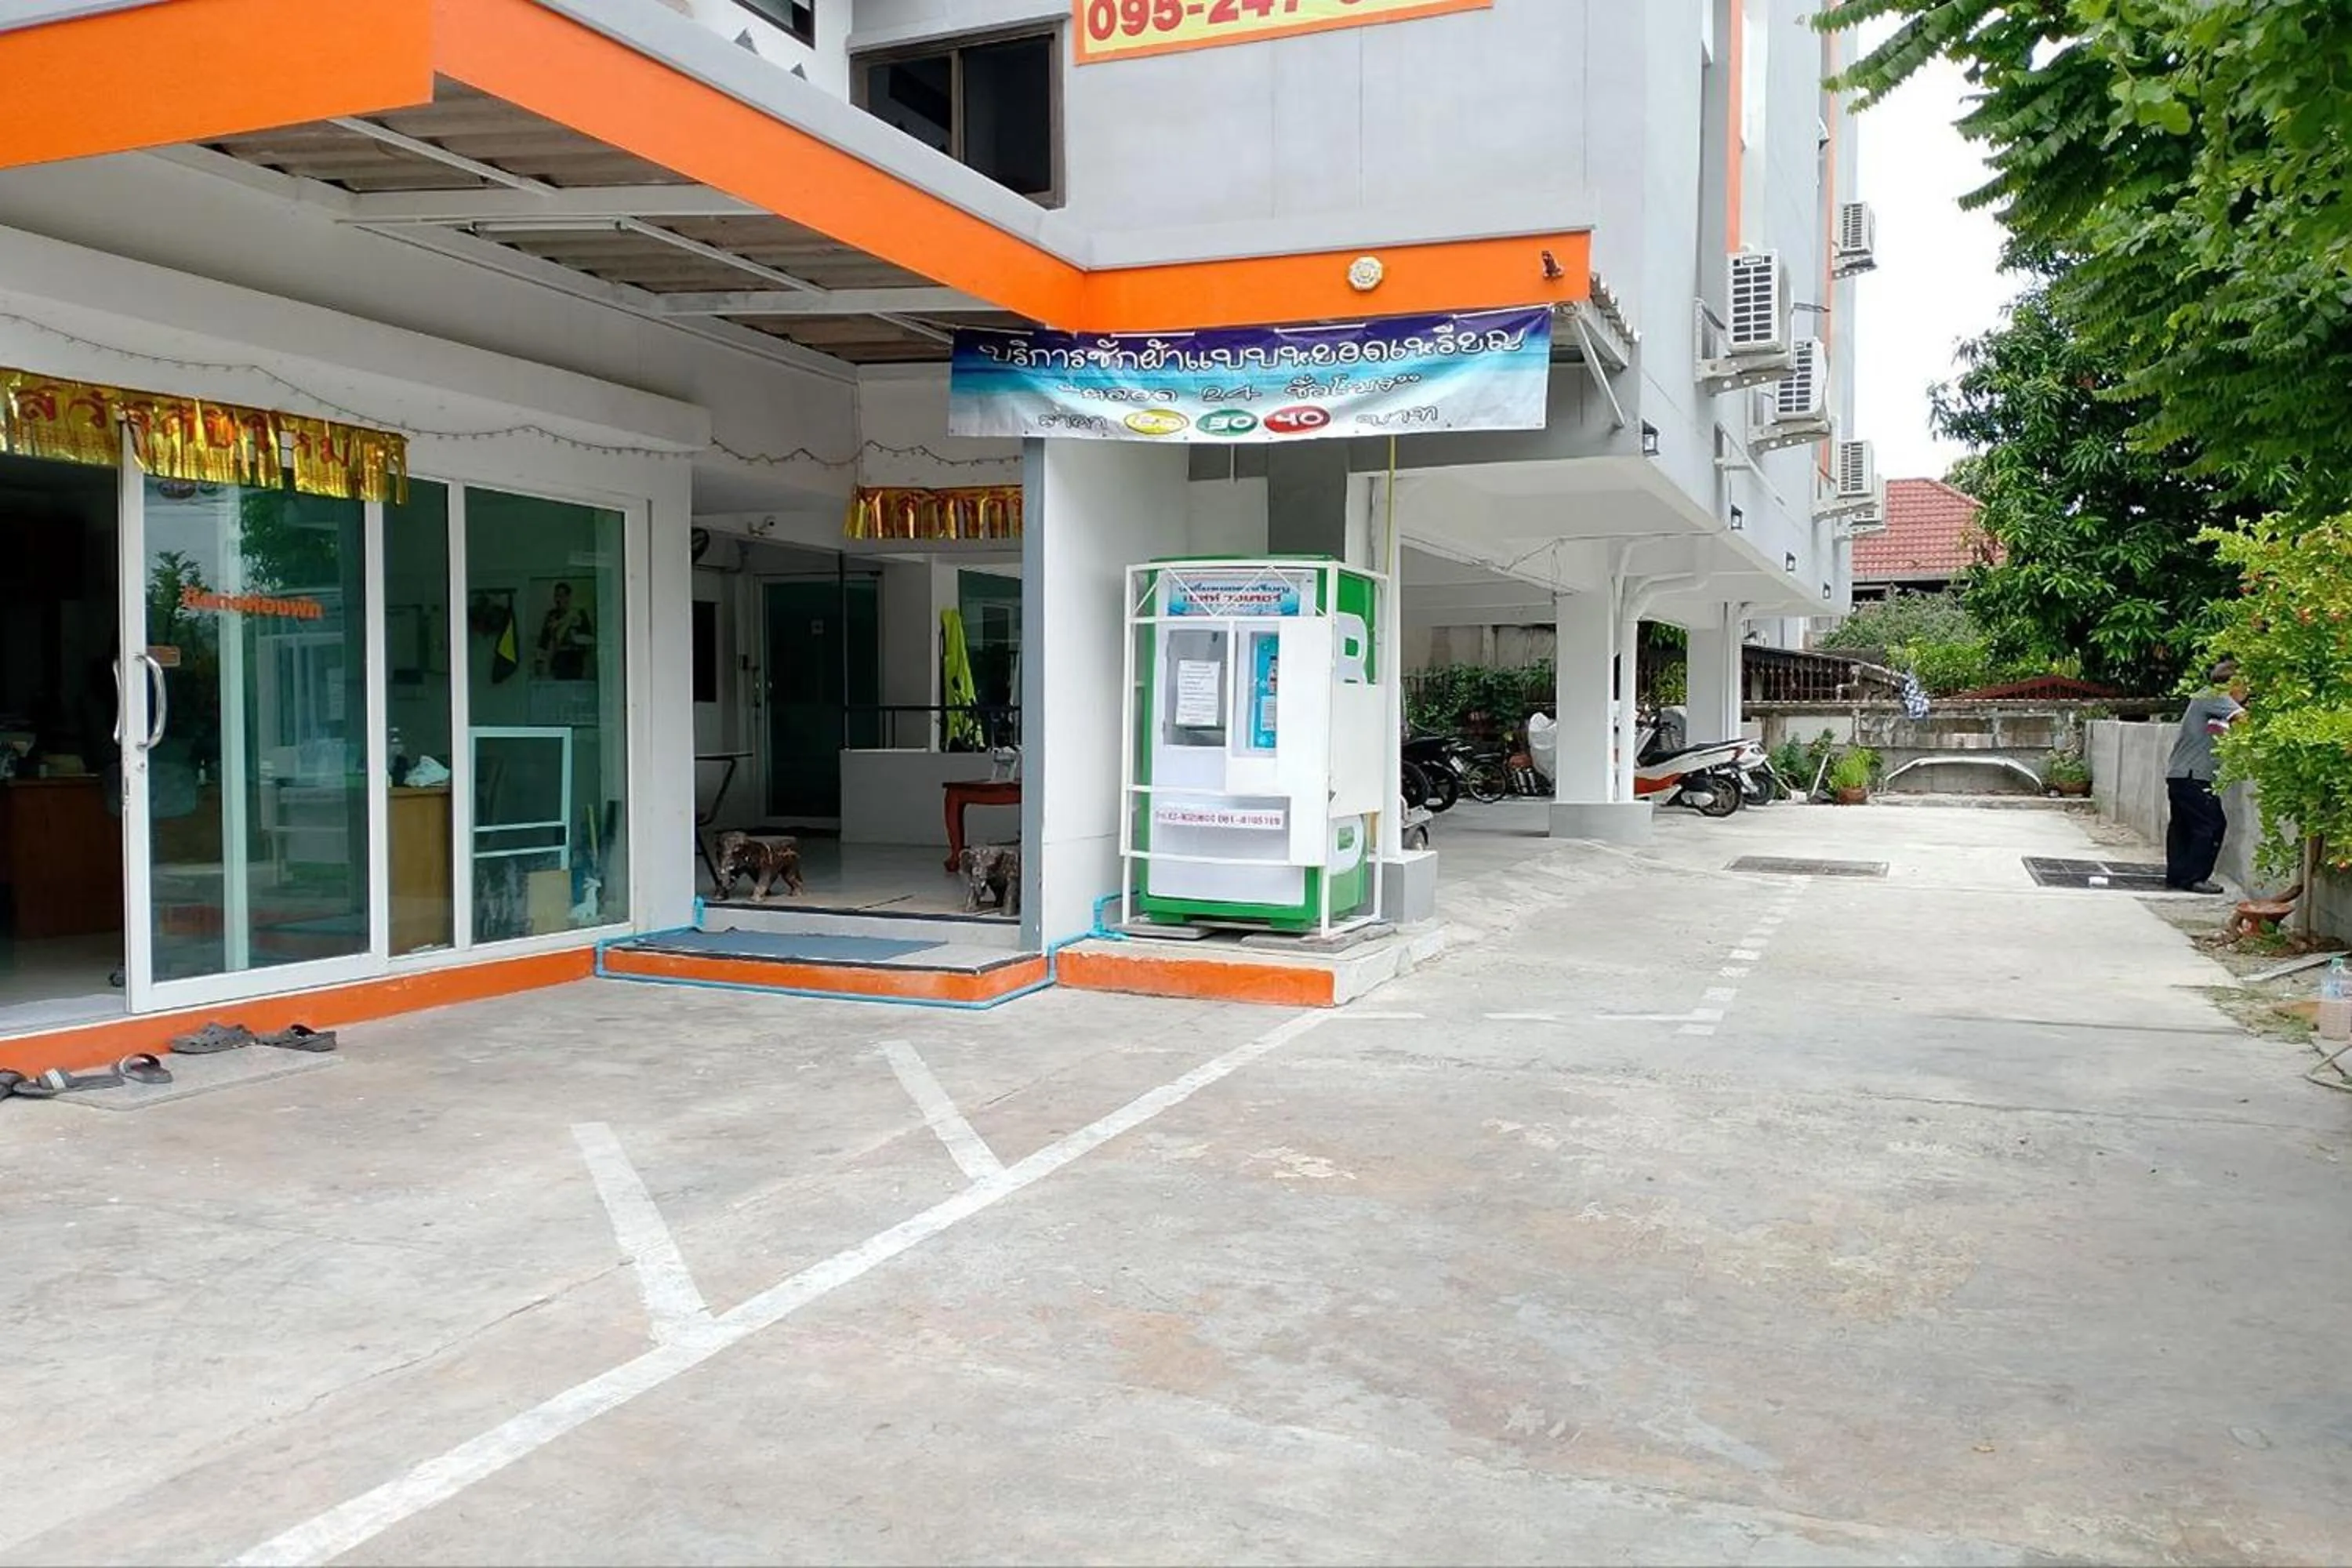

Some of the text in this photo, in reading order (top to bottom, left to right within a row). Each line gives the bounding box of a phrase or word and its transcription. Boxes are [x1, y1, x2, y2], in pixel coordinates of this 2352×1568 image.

[978, 323, 1526, 370] บริการซักผ้าแบบหยอดเหรียญ
[1202, 385, 1263, 402] 24
[1274, 412, 1323, 427] 40
